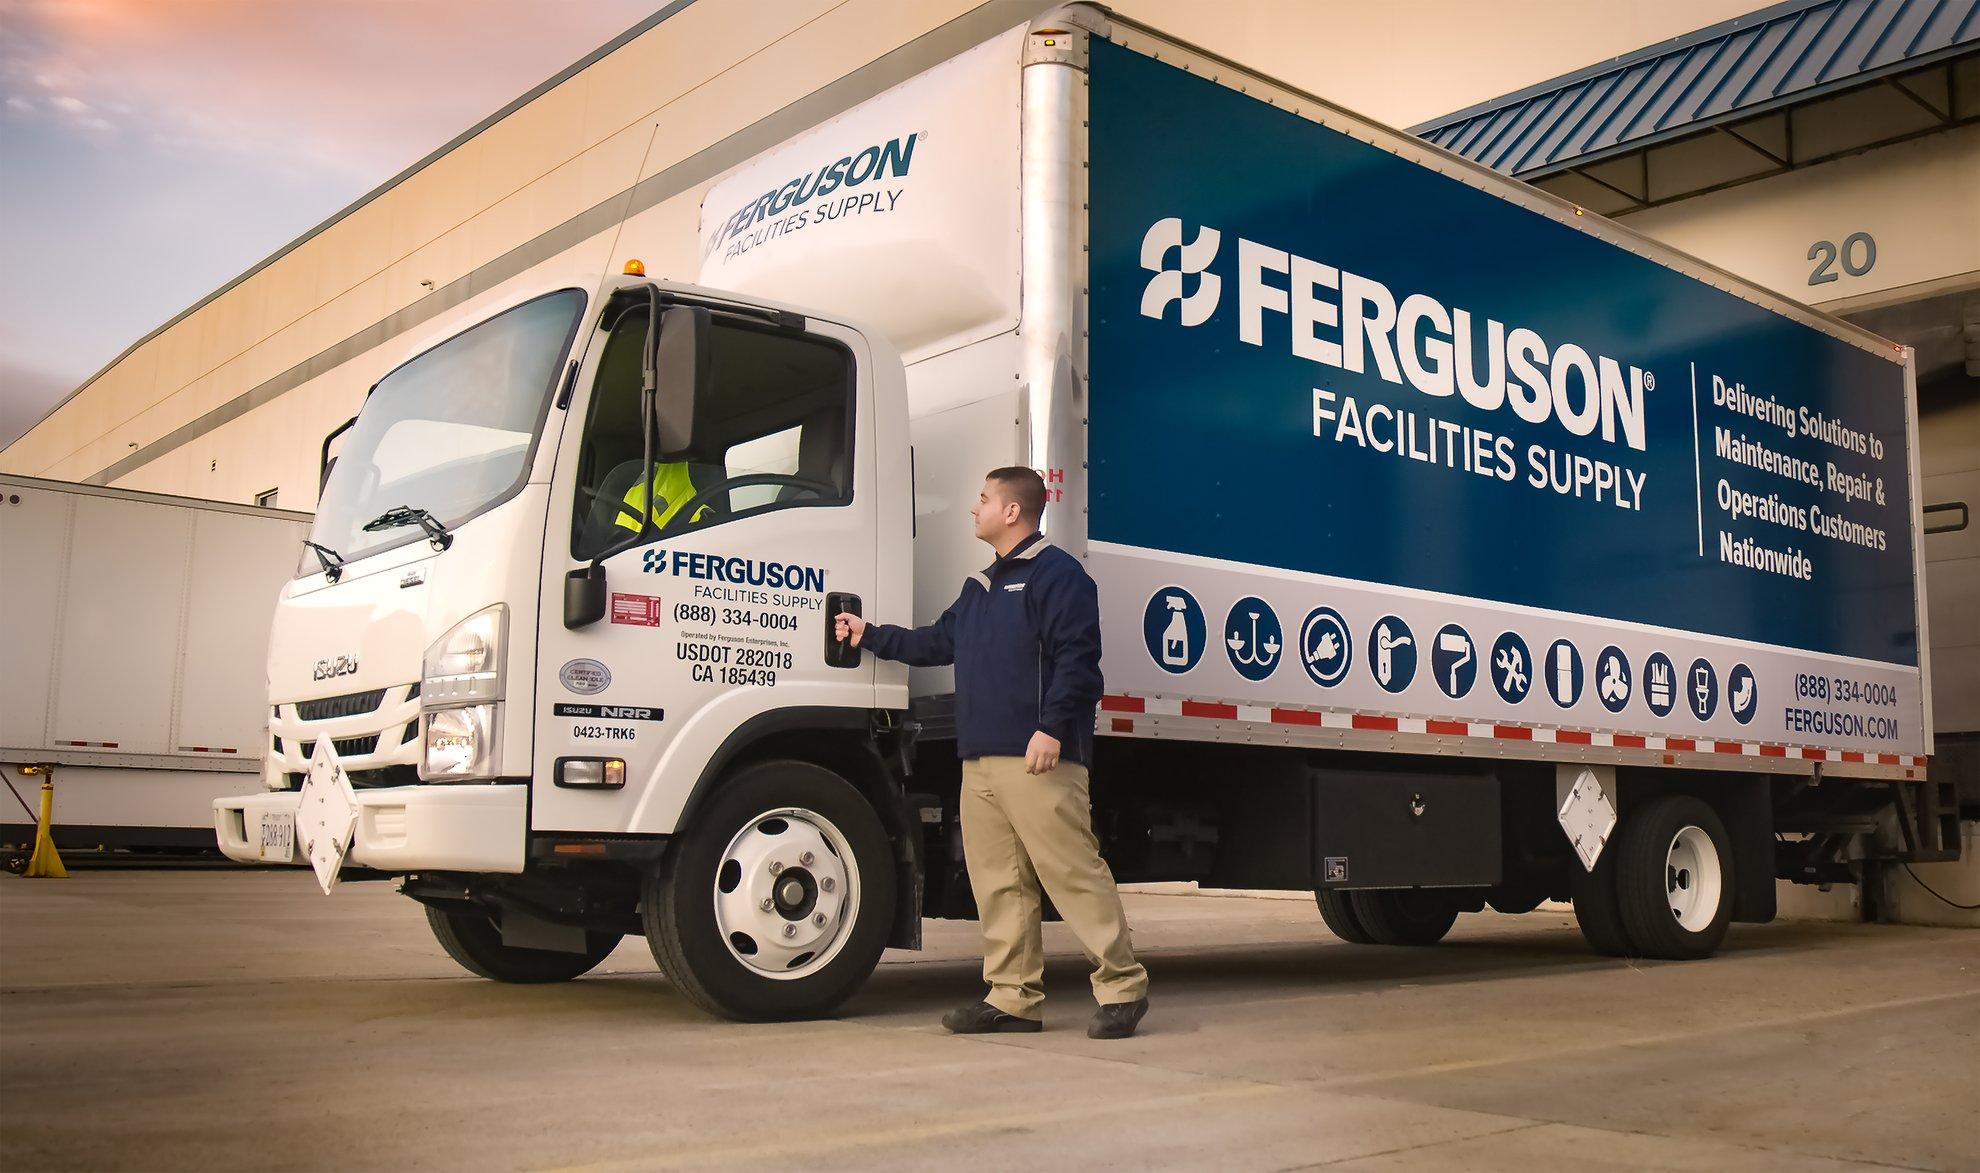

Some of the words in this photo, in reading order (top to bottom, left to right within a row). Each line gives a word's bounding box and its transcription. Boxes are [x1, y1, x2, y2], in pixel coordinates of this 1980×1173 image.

[723, 210, 809, 266] FACILITIES
[814, 190, 904, 224] SUPPLY
[1807, 231, 1877, 286] 20
[1713, 374, 1796, 438] Delivering
[1800, 406, 1866, 455] Solutions
[1869, 432, 1884, 460] to
[1313, 388, 1517, 482] FACILITIES
[1528, 445, 1647, 511] SUPPLY
[1715, 426, 1824, 492] Maintenance,
[1827, 462, 1873, 502] Repair
[1876, 477, 1886, 506] &
[1717, 478, 1807, 531] Operations
[1810, 505, 1887, 551] Customers
[1720, 530, 1812, 580] Nationwide
[672, 551, 825, 593] FERGUSON
[695, 585, 768, 605] FACILITIES
[773, 594, 823, 610] SUPPLY
[674, 603, 716, 626] (888)
[722, 608, 798, 631] 334-0004
[677, 642, 731, 664] USDOT
[736, 648, 792, 669] 282018
[681, 631, 708, 640] Operated
[709, 633, 717, 642] by
[718, 634, 744, 643] Ferguson
[746, 637, 778, 647] Enterprises,
[313, 652, 358, 681] ISUZU
[693, 664, 714, 683] CA
[720, 667, 776, 687] 185439
[1795, 673, 1831, 705] (888)
[1834, 678, 1897, 707] 334-0004
[563, 706, 592, 714] ISUZU
[601, 706, 651, 719] NRR
[1785, 707, 1898, 740] FERGUSON.COM
[573, 725, 636, 740] 0423-TRK6
